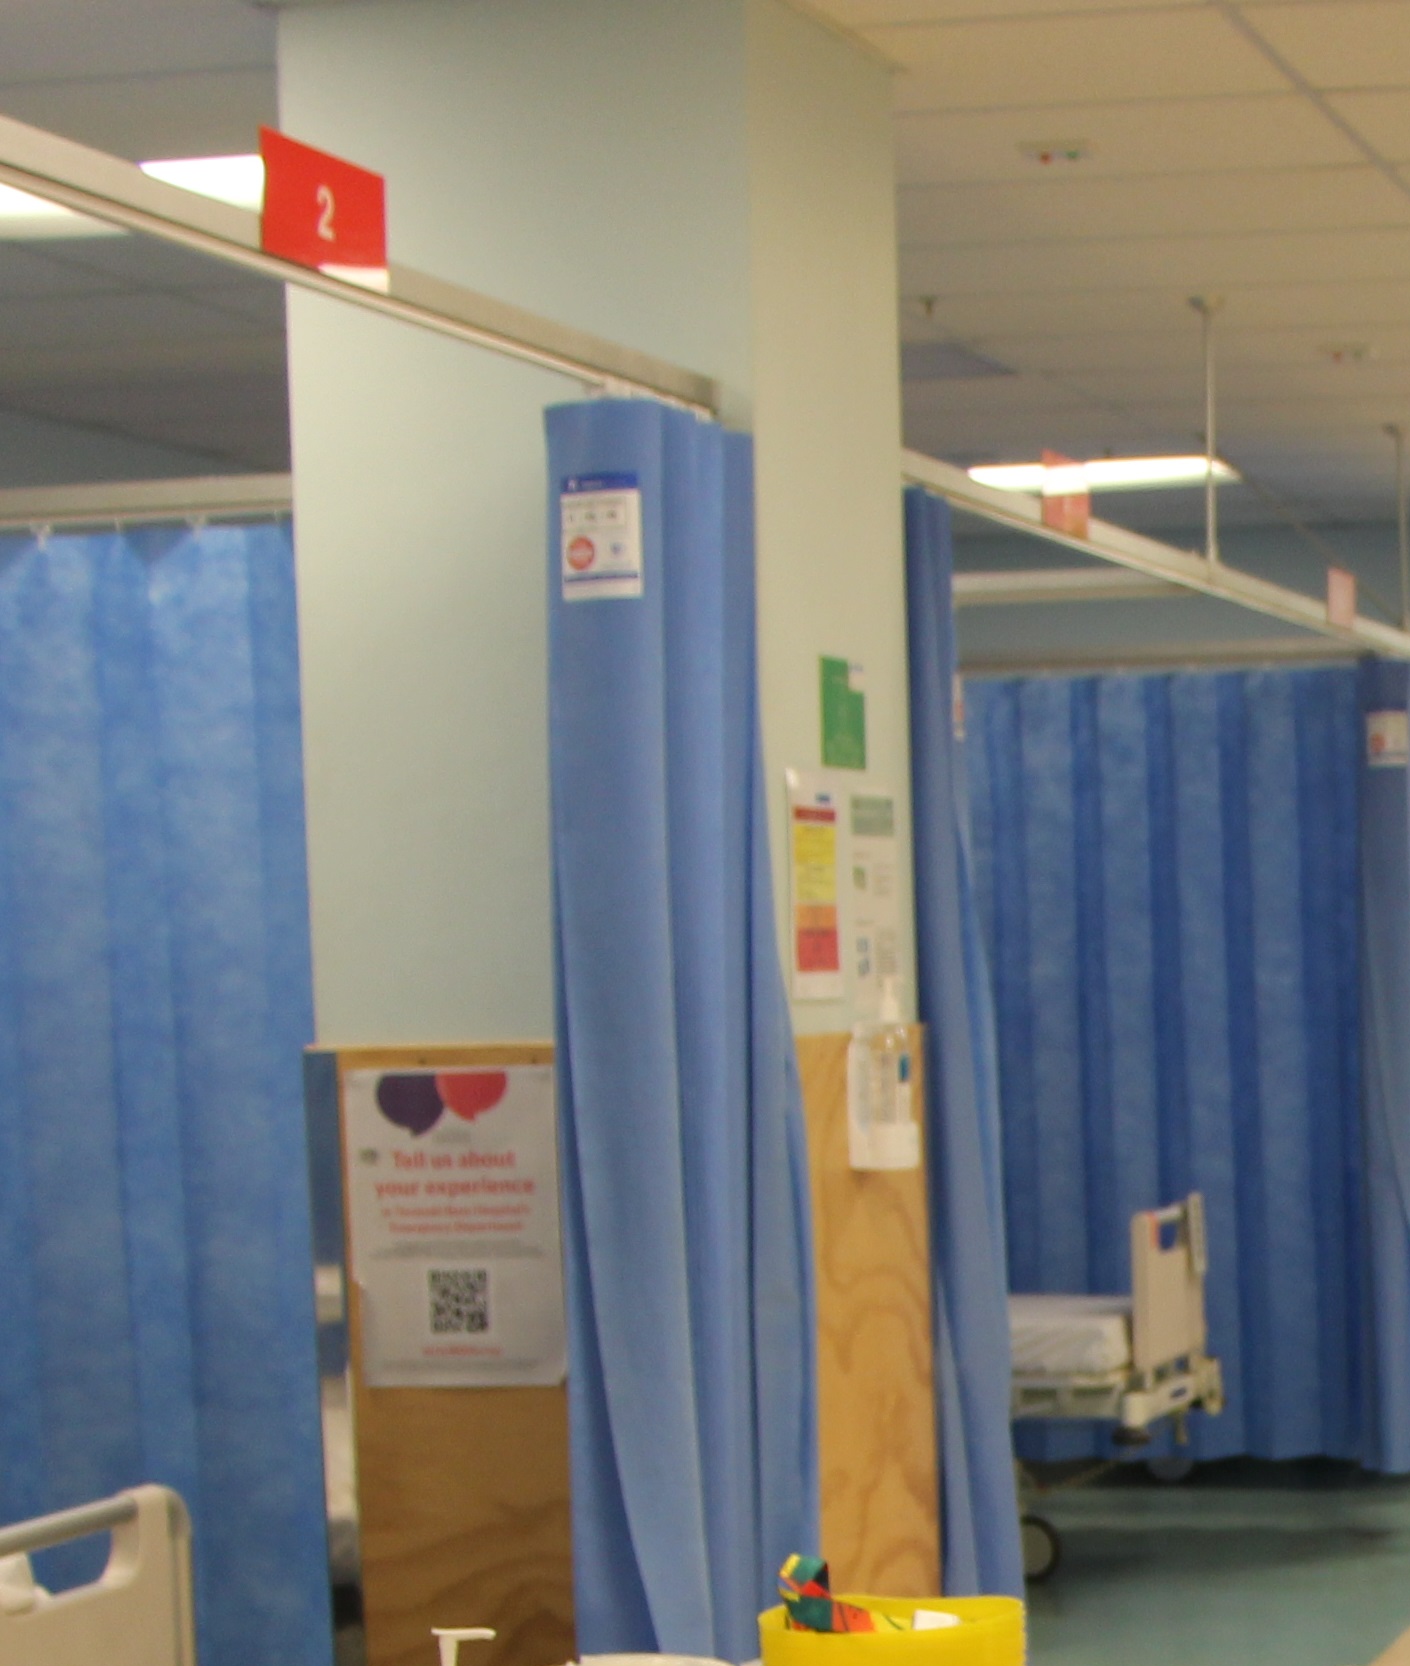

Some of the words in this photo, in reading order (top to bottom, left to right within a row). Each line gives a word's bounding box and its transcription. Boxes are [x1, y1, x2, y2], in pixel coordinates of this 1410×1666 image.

[316, 183, 336, 242] 2
[393, 1151, 425, 1170] Tell
[430, 1154, 452, 1170] us
[459, 1151, 516, 1170] about
[375, 1181, 419, 1198] your
[424, 1178, 536, 1197] experience
